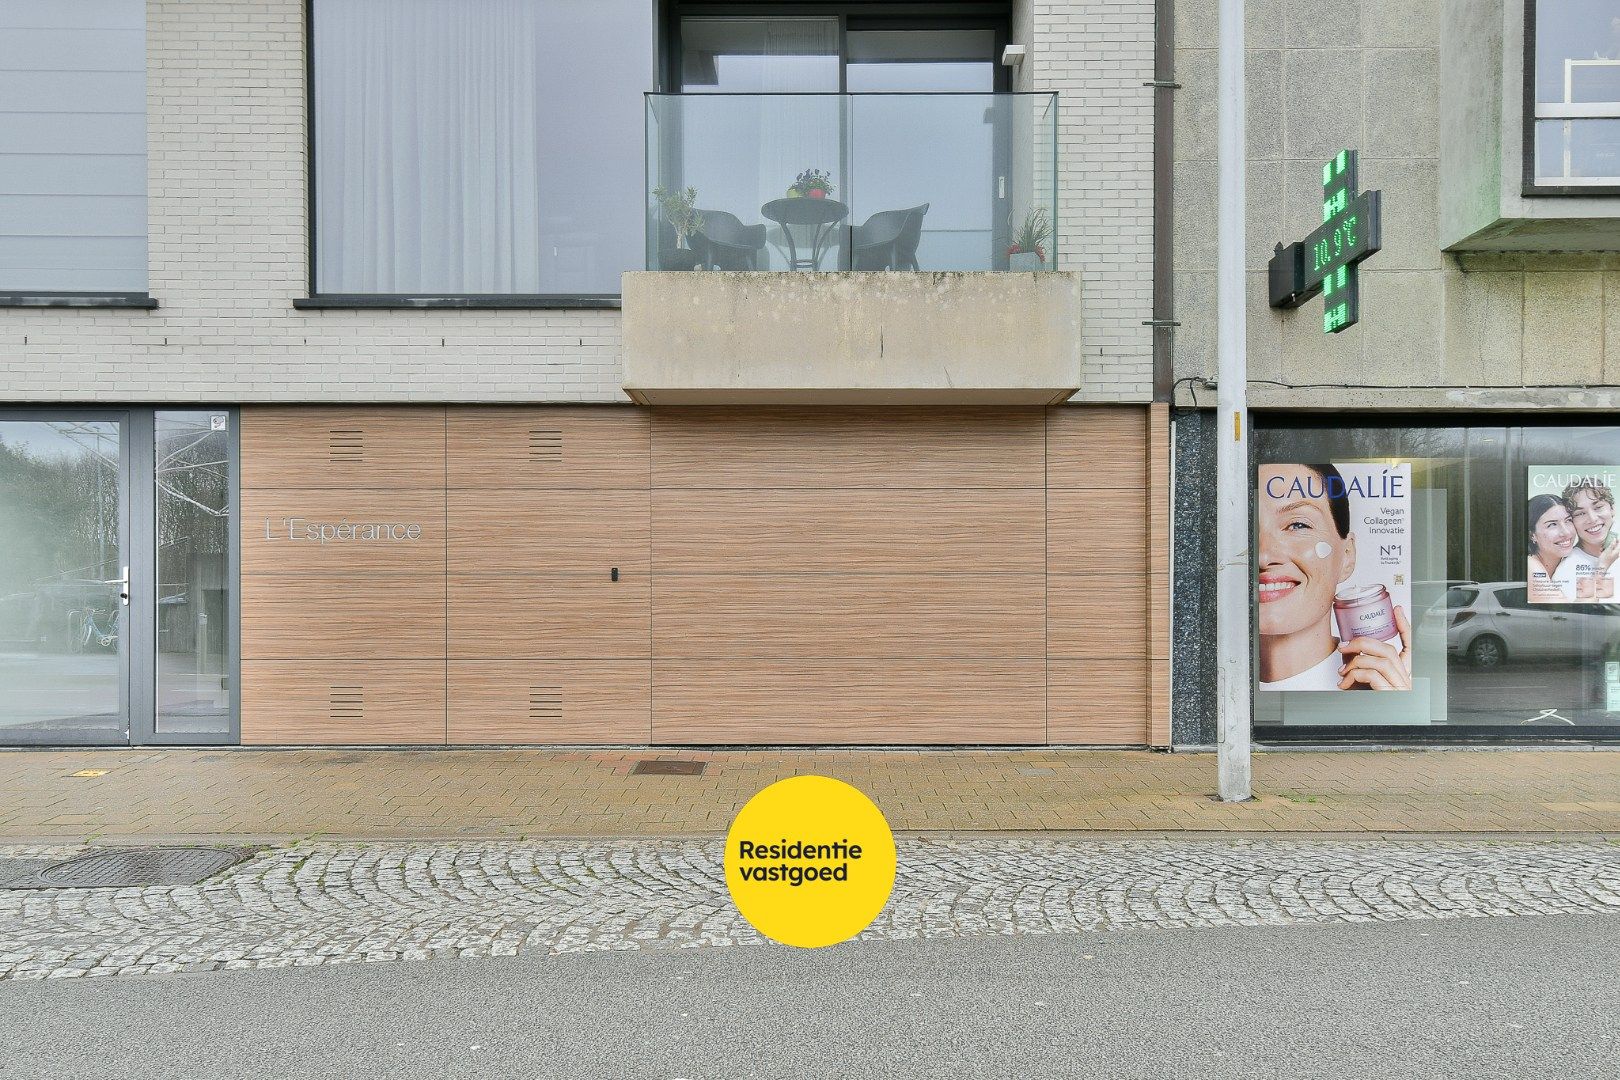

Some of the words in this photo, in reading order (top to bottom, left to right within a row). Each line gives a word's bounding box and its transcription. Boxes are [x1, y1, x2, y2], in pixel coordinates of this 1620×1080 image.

[1266, 469, 1404, 499] CAUDALÍE
[1380, 507, 1405, 516] Vegan
[264, 517, 422, 544] L'Espérance
[1369, 526, 1405, 534] Innovatie
